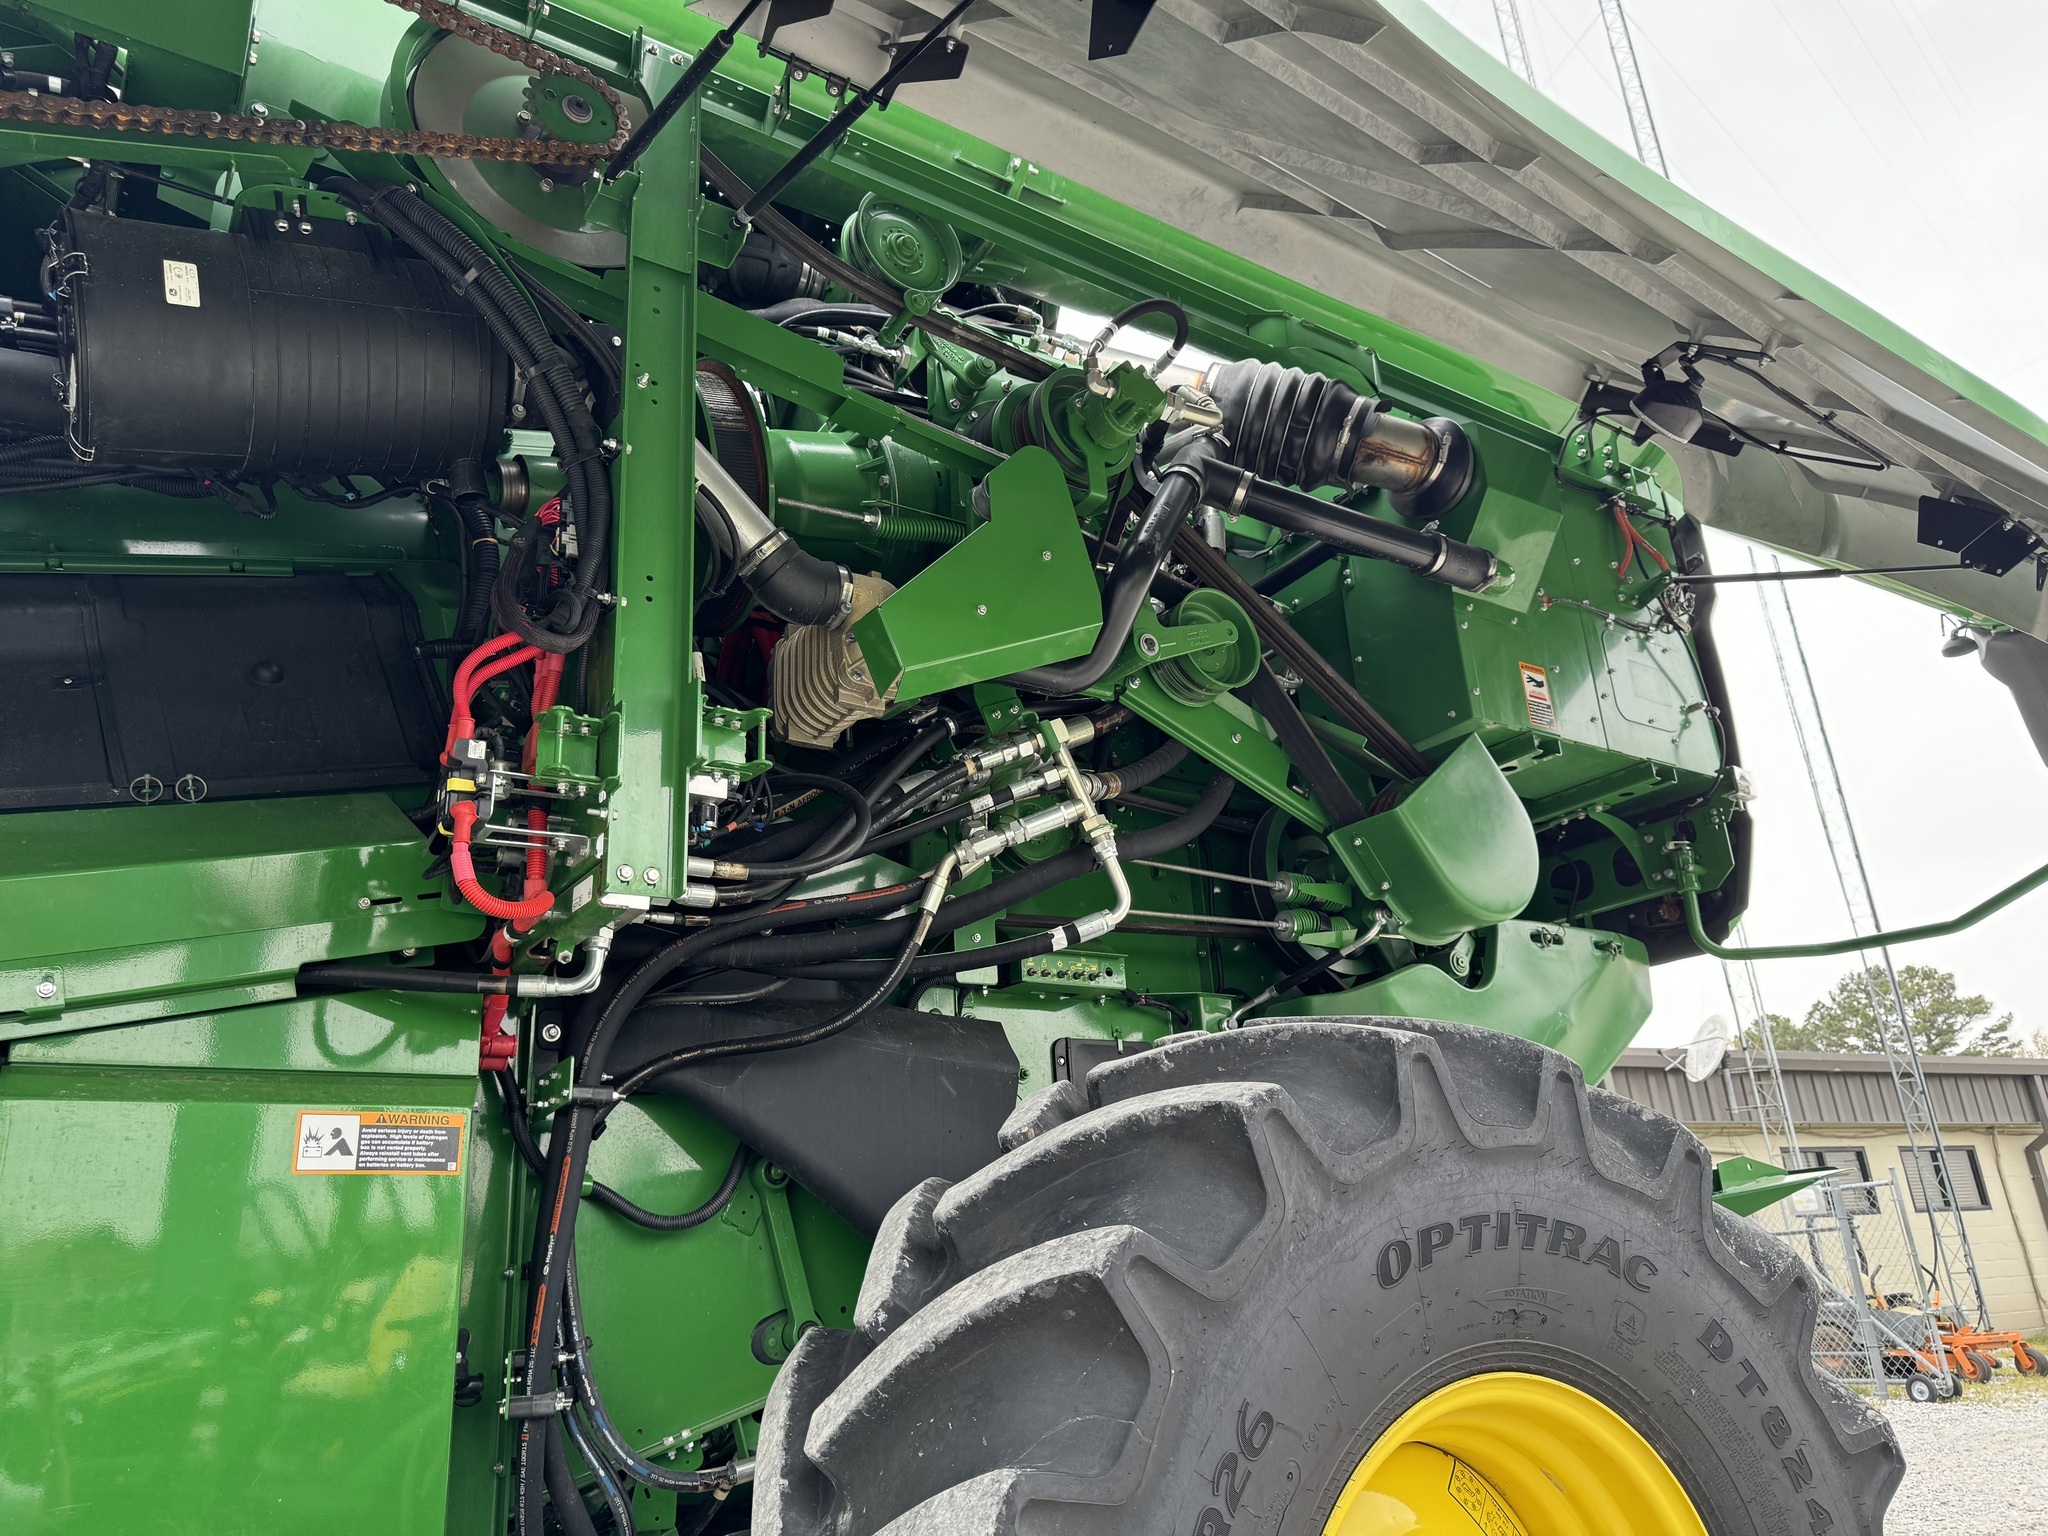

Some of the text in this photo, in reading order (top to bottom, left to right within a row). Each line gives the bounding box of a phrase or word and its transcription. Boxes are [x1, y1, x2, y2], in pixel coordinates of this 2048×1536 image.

[883, 976, 893, 988] Flame
[388, 1114, 450, 1125] WARNING
[568, 1129, 576, 1141] MPa
[1376, 1210, 1659, 1290] OPTITRAC
[1503, 1288, 1548, 1304] ROTATION
[528, 1346, 537, 1369] 2G-11C
[526, 1368, 534, 1386] MSHA
[1697, 1316, 1835, 1536] DT824
[612, 1496, 625, 1514] 2G-11C
[619, 1513, 630, 1527] MSHA
